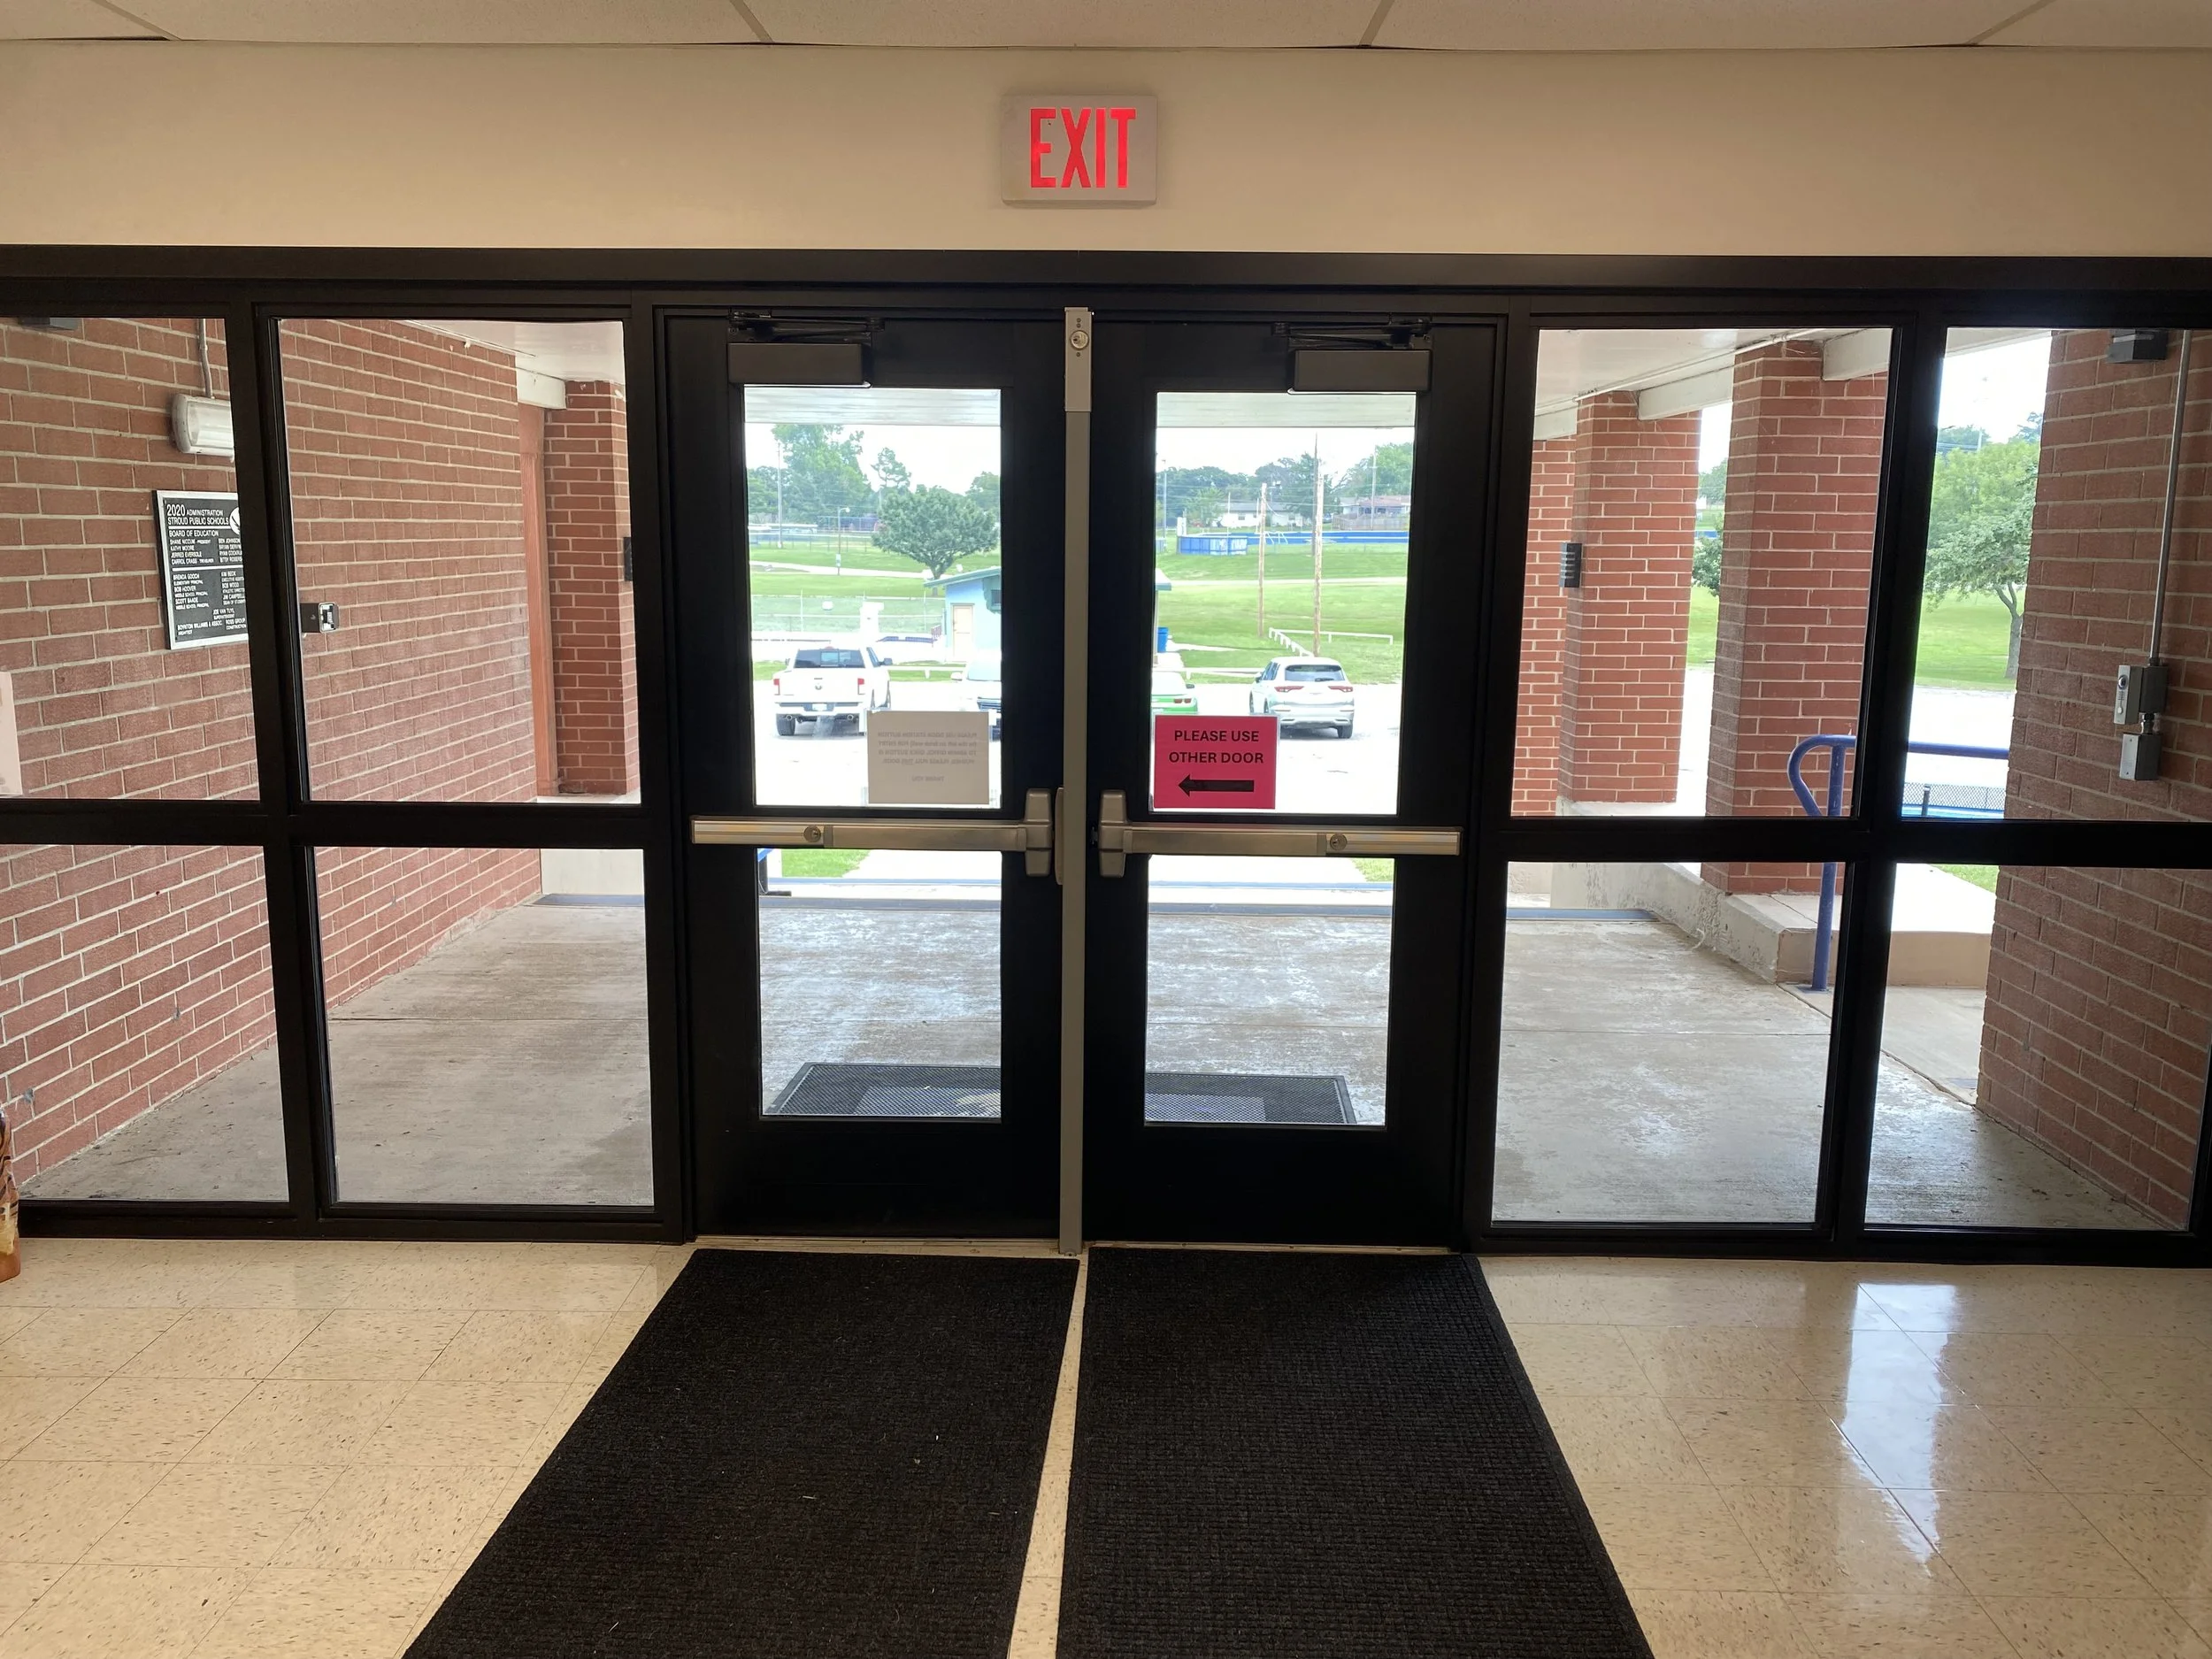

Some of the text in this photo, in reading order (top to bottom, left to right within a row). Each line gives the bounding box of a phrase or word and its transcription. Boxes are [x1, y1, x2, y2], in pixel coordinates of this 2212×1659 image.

[1030, 108, 1136, 188] EXIT
[167, 504, 185, 516] 2020
[1174, 730, 1259, 741] PLEASE USE
[1169, 752, 1264, 764] OTHER DOOR
